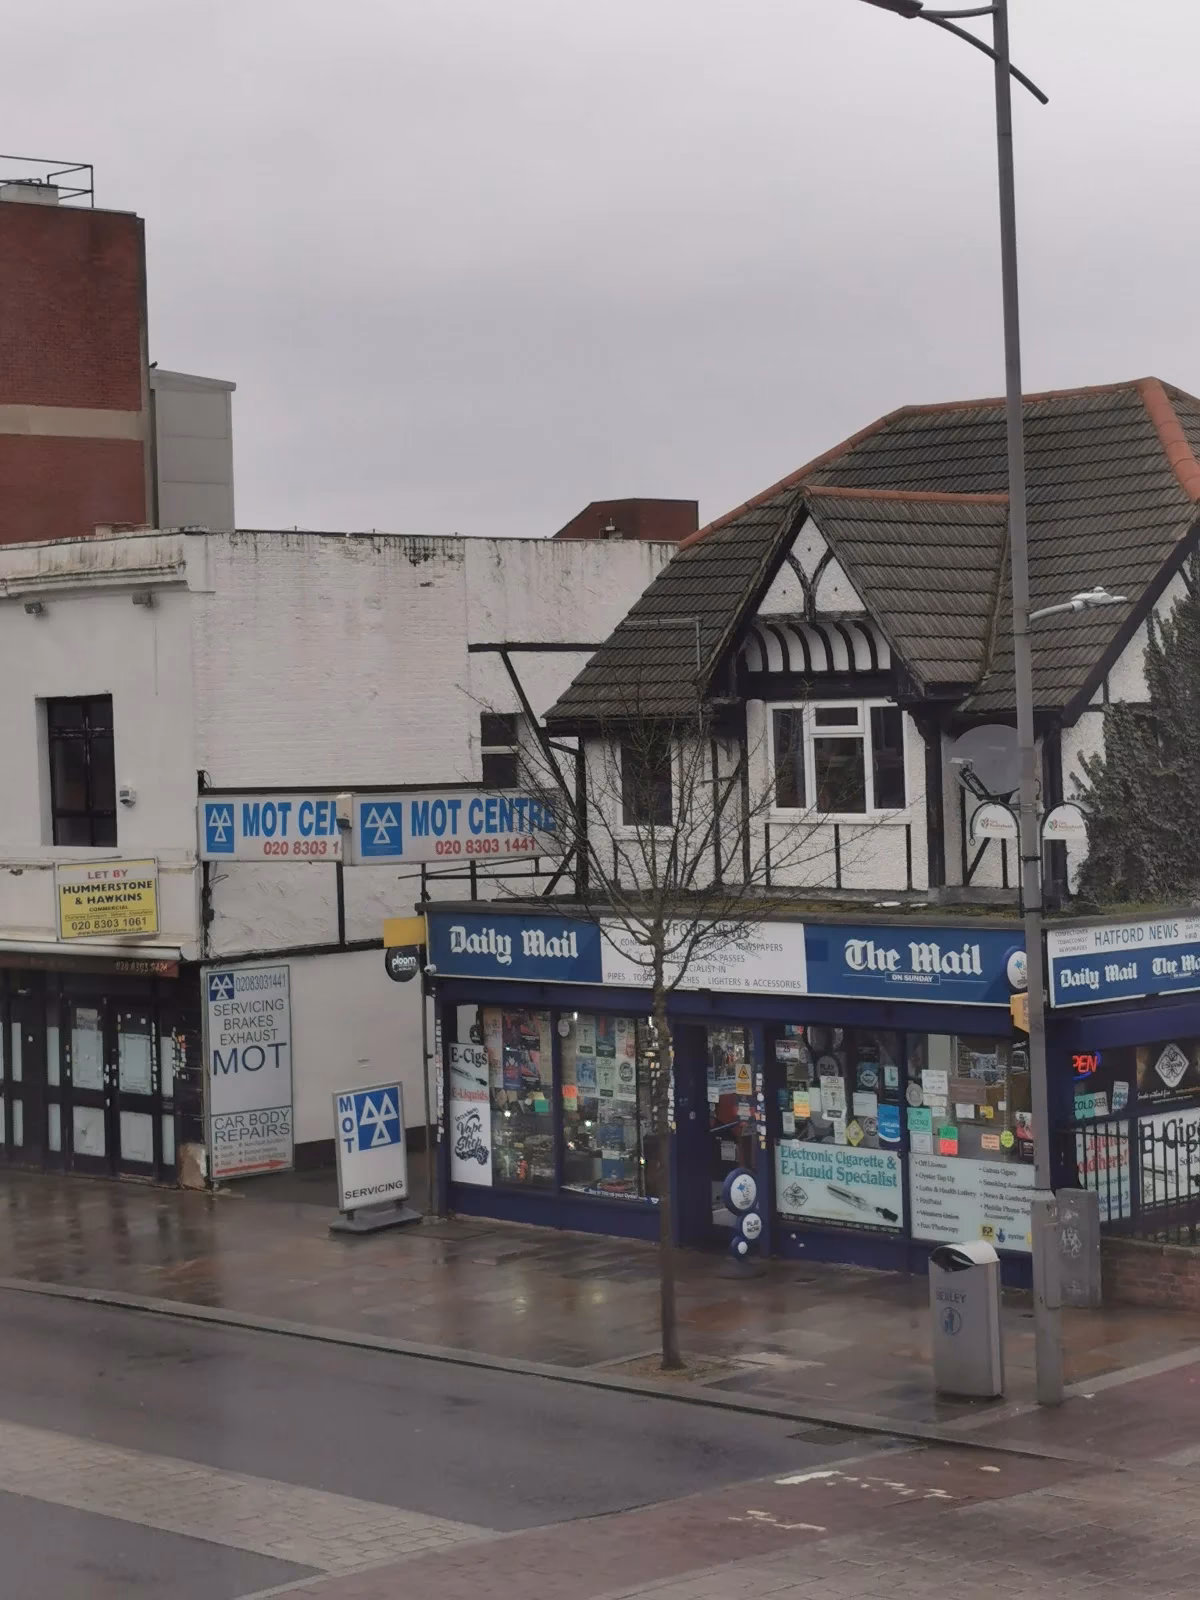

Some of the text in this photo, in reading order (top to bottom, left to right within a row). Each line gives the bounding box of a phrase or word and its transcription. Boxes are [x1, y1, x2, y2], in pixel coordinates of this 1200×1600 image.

[242, 801, 292, 837] MOT
[411, 797, 557, 837] MOT CENTRE
[263, 841, 289, 856] 020
[292, 840, 328, 855] 8303
[435, 836, 536, 856] 020 8303 1441
[87, 868, 128, 880] LET BY
[62, 880, 153, 894] HUMMERSTONE
[74, 892, 142, 905] & HAWKINS
[71, 917, 147, 931] 020 8303 1061
[1094, 927, 1144, 946] HATFORD
[1149, 923, 1179, 940] NEWS
[449, 925, 579, 966] Daily Mail
[392, 955, 417, 969] ploom
[720, 954, 745, 962] PASSES
[844, 938, 983, 976] The Mail
[1151, 956, 1179, 976] The
[718, 965, 726, 973] IN
[904, 974, 934, 983] SUNDAY
[1060, 961, 1138, 990] Daily Mail
[235, 974, 286, 993] 02083031441
[607, 972, 626, 981] PIPES
[667, 975, 700, 985] POCHES
[707, 977, 742, 986] LIGHTERS
[744, 978, 750, 987] &
[752, 979, 802, 989] ACCESSORIES
[213, 998, 284, 1017] SERVICING
[223, 1014, 274, 1031] BRAKES
[220, 1028, 279, 1046] EXHAUST
[213, 1042, 287, 1076] MOT
[451, 1046, 488, 1068] E-Cigs
[214, 1109, 290, 1131] CAR BODY
[339, 1095, 355, 1154] MOT
[214, 1122, 290, 1144] REPAIRS
[780, 1145, 897, 1170] Electronic Cigarette &
[781, 1160, 898, 1187] E-Liquid Specialist
[344, 1180, 403, 1200] SERVICING
[957, 1189, 977, 1198] Lottery
